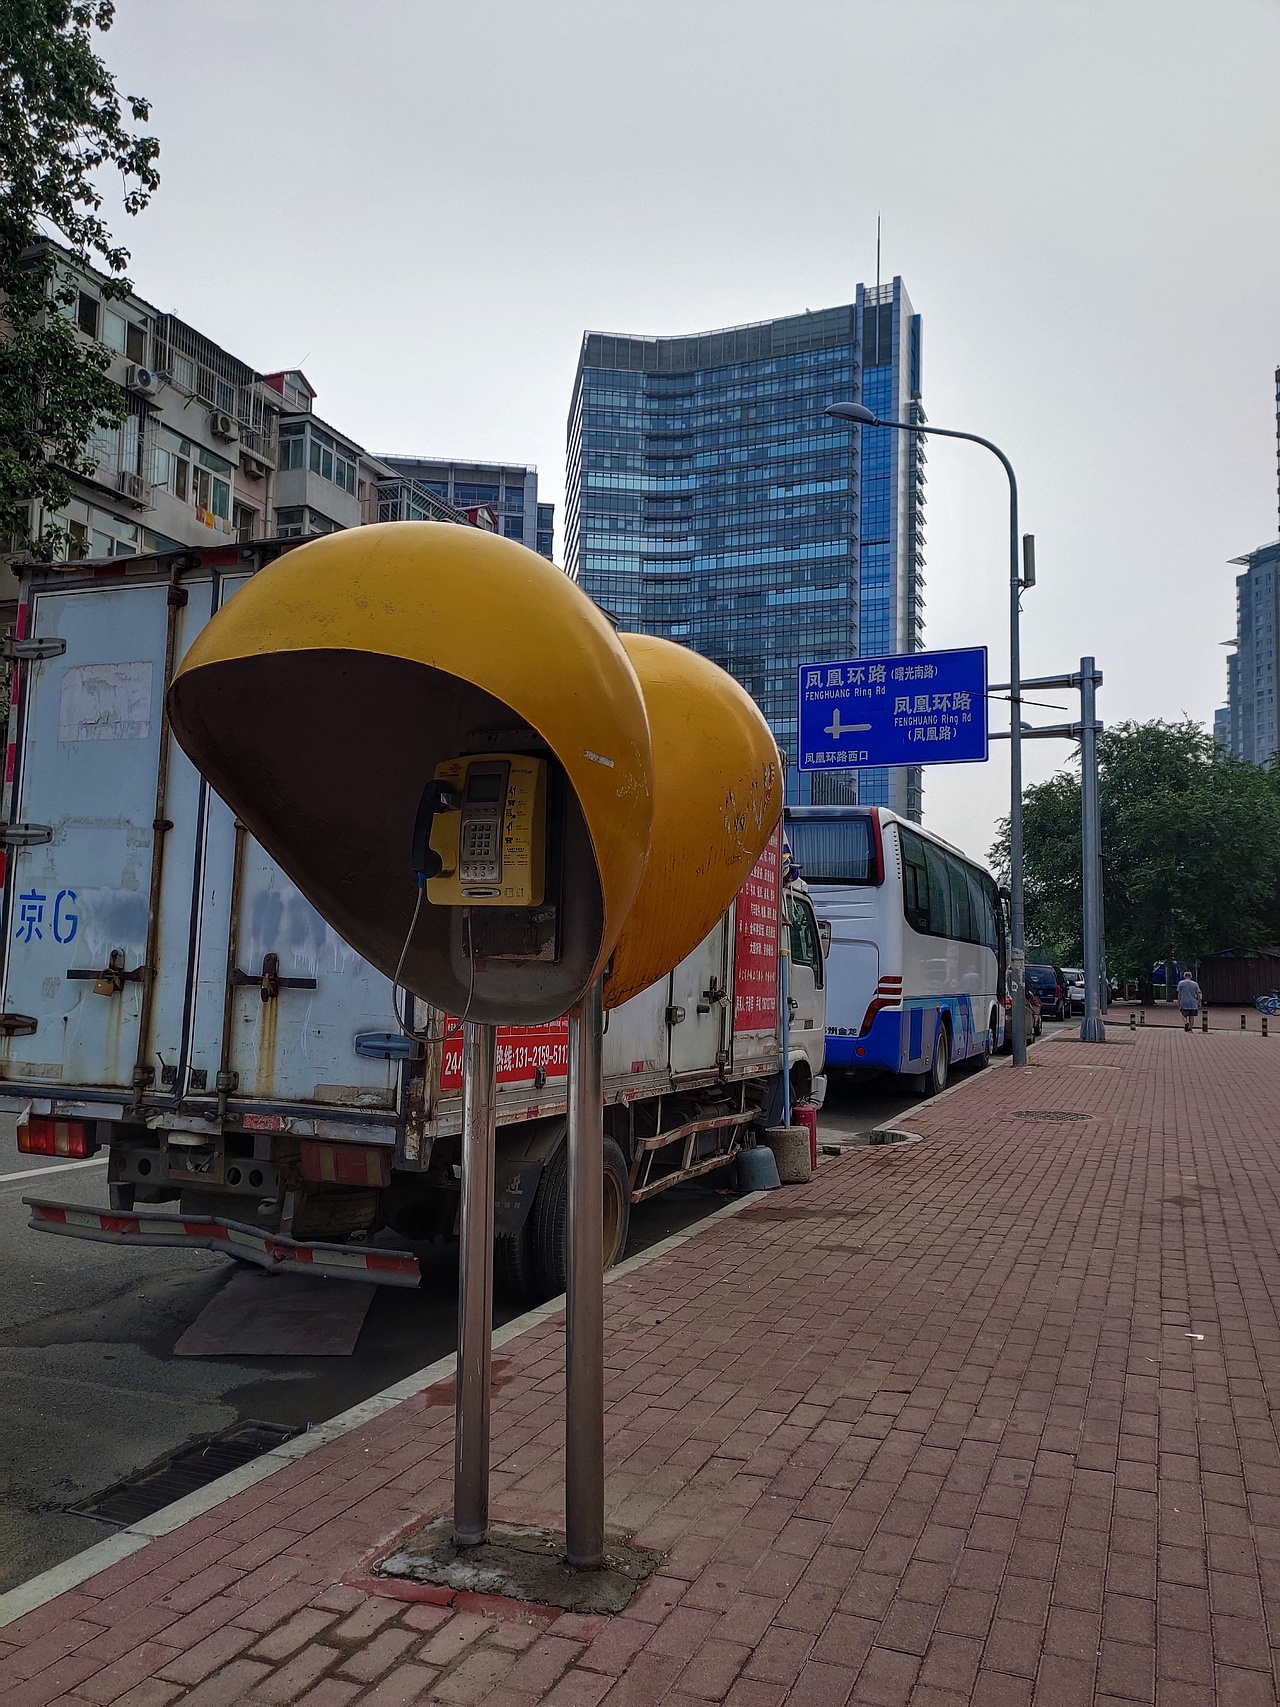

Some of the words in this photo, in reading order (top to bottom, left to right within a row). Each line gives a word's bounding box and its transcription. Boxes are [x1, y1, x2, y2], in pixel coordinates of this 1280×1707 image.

[805, 664, 887, 688] 凤凰环路
[805, 688, 850, 701] FENGHUANG
[854, 687, 872, 698] Ring
[875, 685, 886, 695] Rd
[893, 692, 972, 715] 凤凰环路
[894, 714, 938, 727] FENGHUANG
[941, 713, 959, 726] Ring
[962, 712, 972, 723] Rd
[908, 726, 957, 742] (凤凰路)
[805, 751, 868, 764] 凤凰环路西口
[15, 888, 78, 944] 京G
